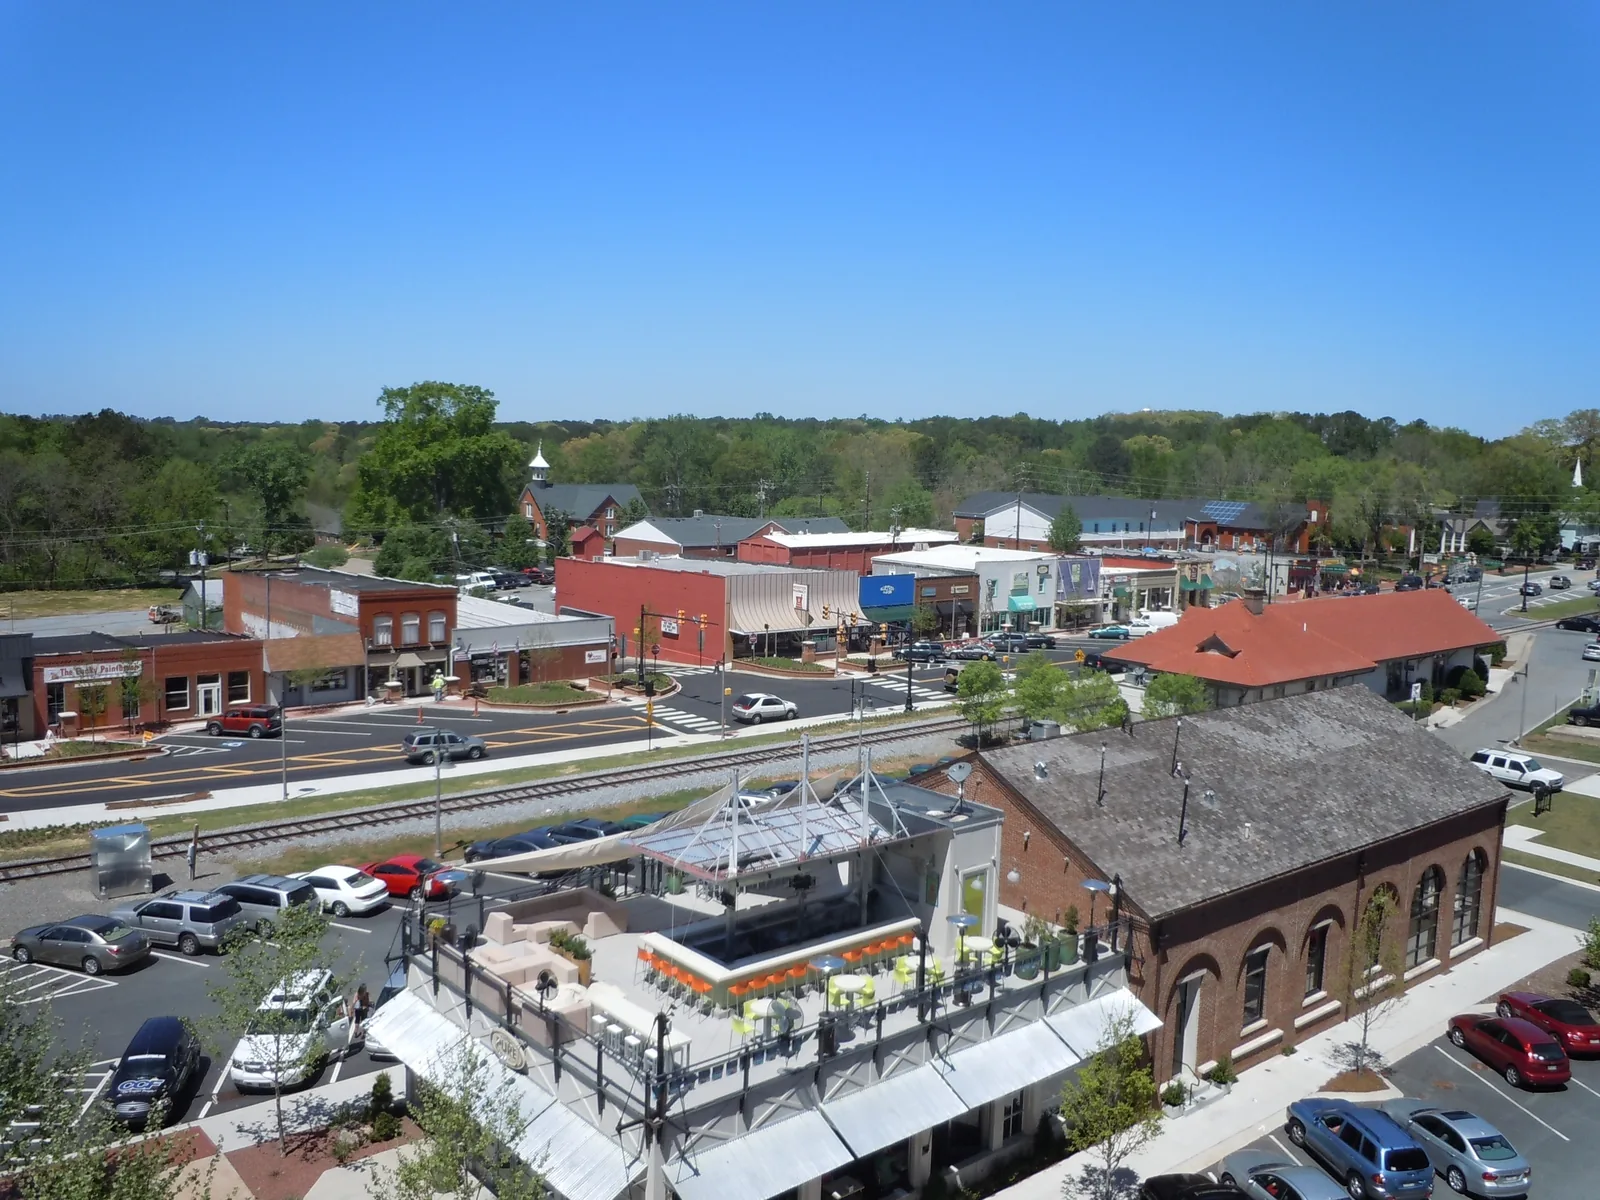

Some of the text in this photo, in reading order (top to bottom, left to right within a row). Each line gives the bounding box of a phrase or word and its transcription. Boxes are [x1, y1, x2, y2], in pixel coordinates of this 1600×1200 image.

[60, 668, 73, 677] The
[100, 662, 139, 674] Paintb
[495, 1034, 517, 1060] PURE
